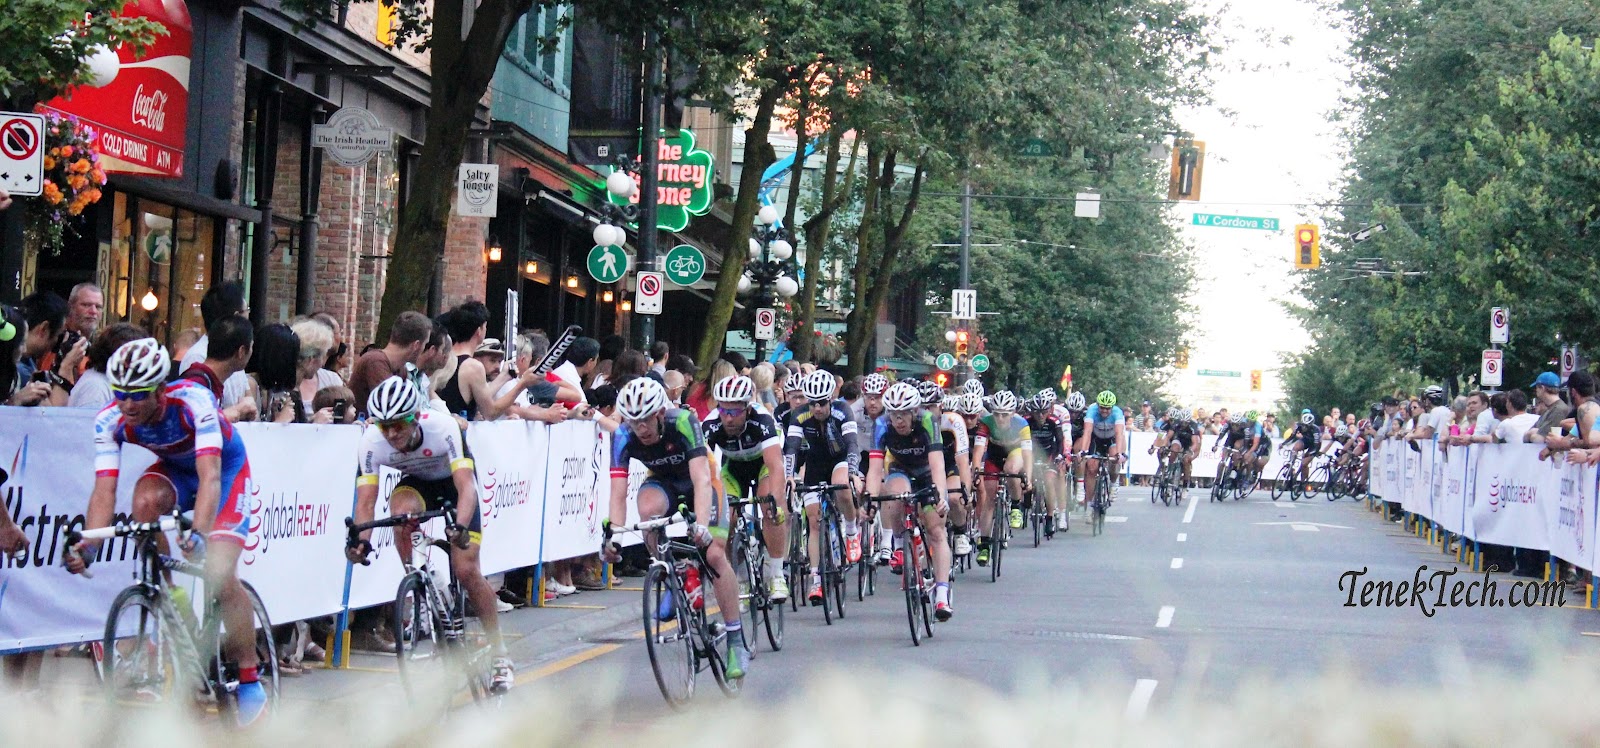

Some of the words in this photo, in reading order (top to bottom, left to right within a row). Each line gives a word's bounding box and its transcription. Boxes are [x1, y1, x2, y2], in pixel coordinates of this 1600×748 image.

[102, 132, 122, 154] COLD
[123, 139, 148, 162] DRINKS
[317, 135, 332, 143] The
[334, 135, 353, 144] Irish
[355, 136, 387, 146] Heather
[156, 152, 171, 170] ATM
[466, 169, 490, 182] Salty
[462, 179, 494, 193] Tongue
[1198, 214, 1209, 225] W
[1213, 216, 1258, 228] Cordova
[1262, 219, 1275, 229] St
[954, 421, 967, 448] OPTUM
[648, 452, 686, 466] xergy
[262, 491, 330, 553] globalRELAY
